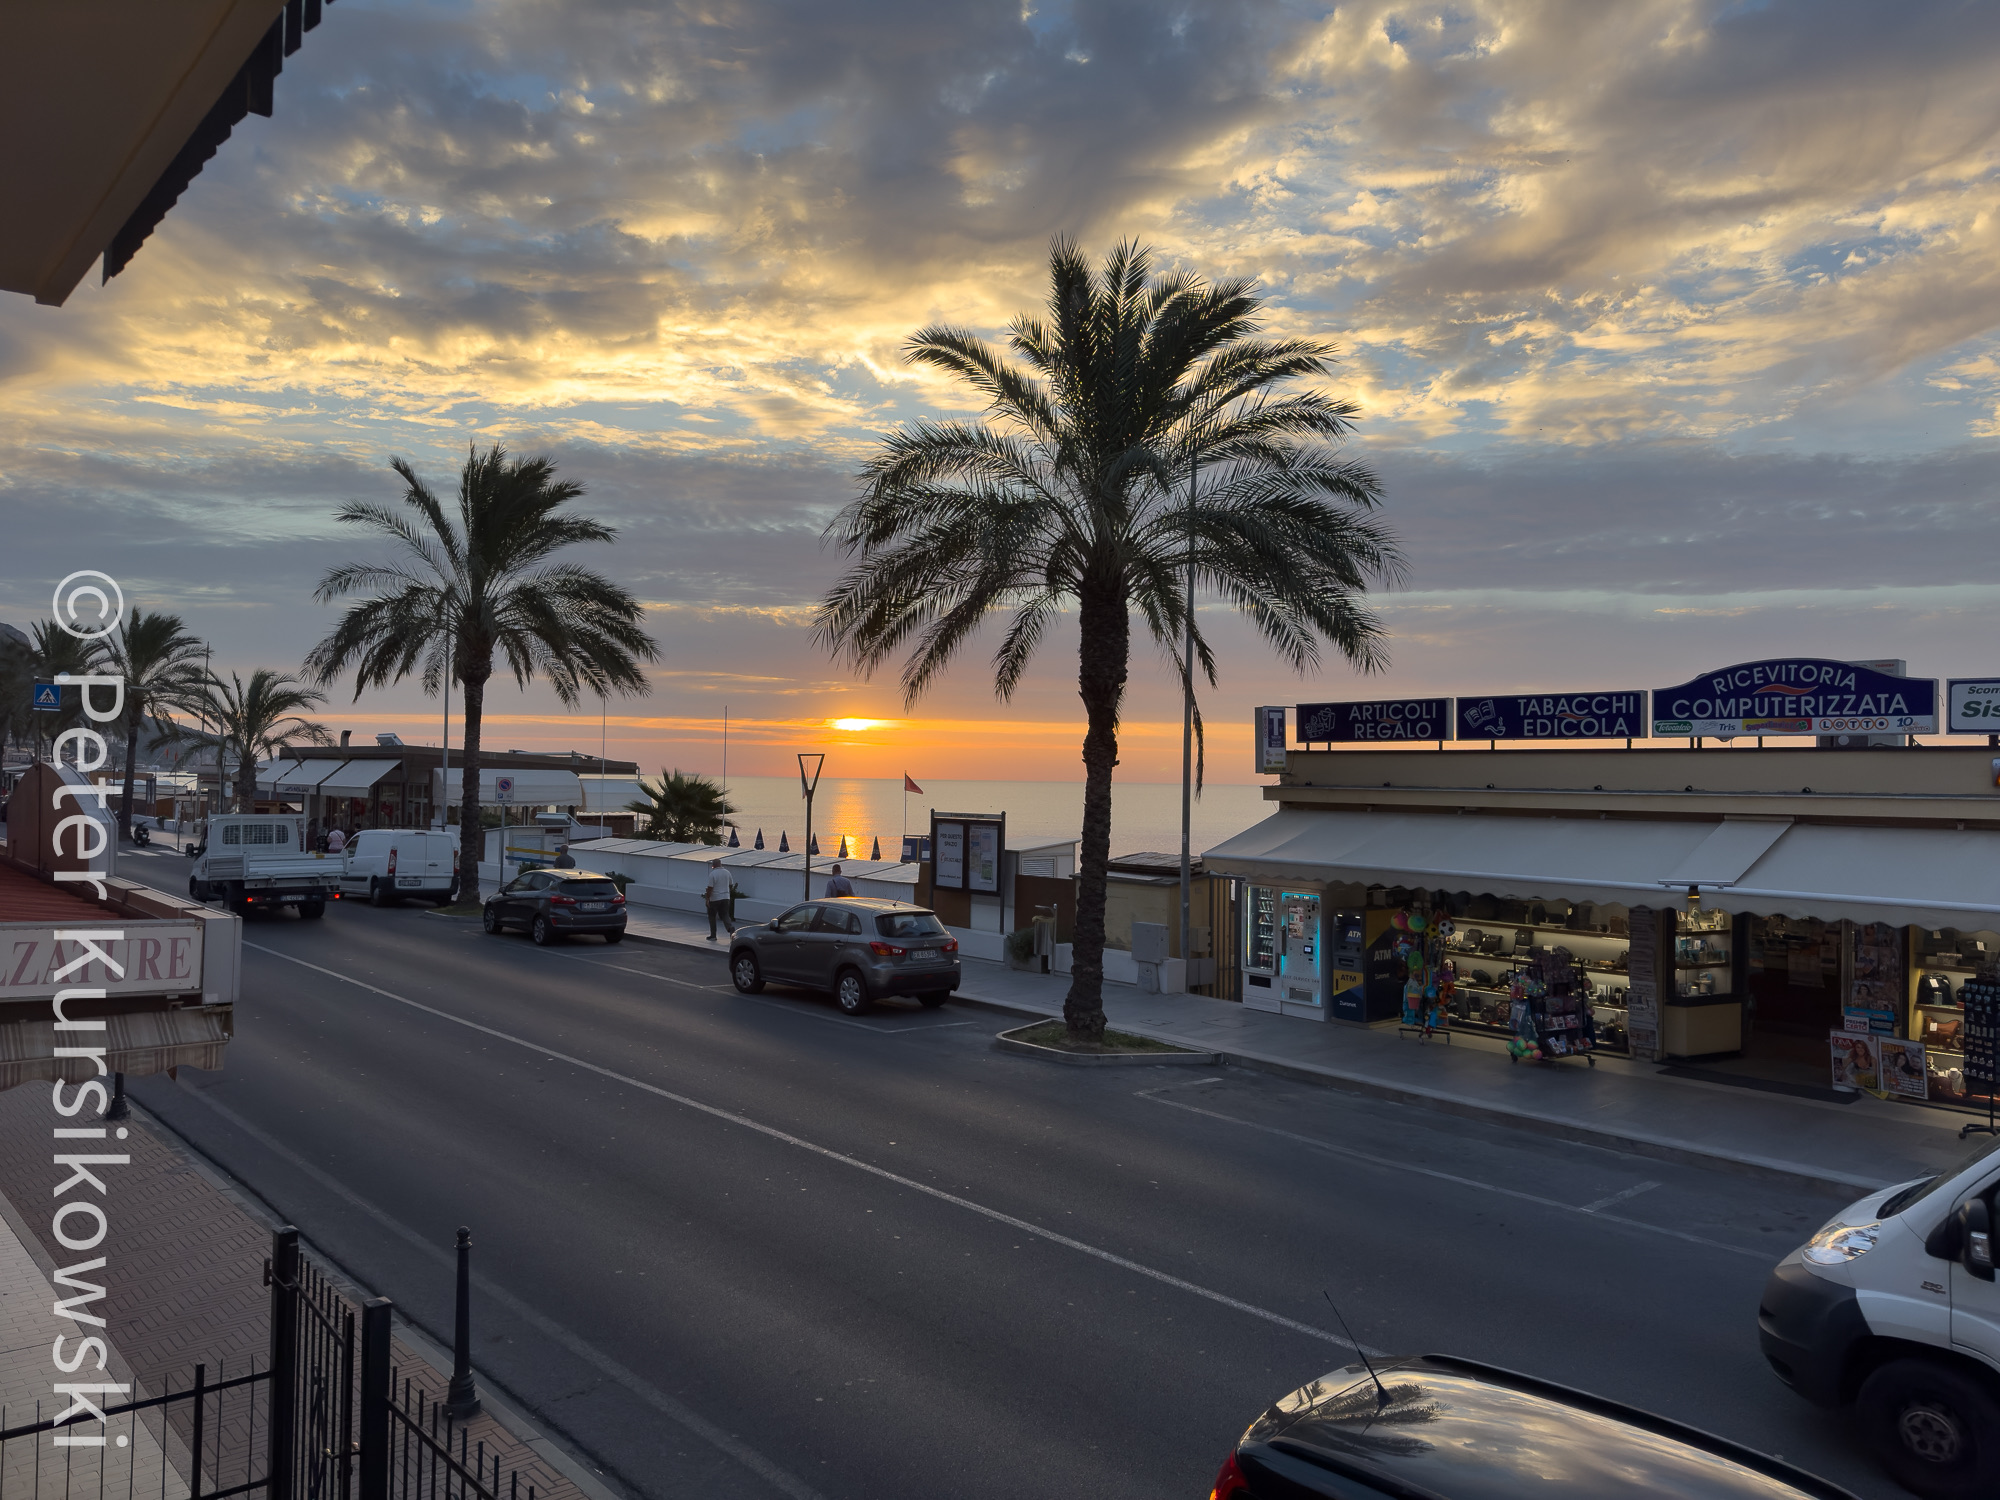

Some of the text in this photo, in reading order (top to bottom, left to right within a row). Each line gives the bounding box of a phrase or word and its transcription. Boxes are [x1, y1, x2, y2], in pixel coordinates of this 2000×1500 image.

[1712, 664, 1856, 695] RICEVITORIA
[1348, 702, 1436, 721] ARTICOLI
[1517, 695, 1634, 716] TABACCHI
[1672, 693, 1909, 718] COMPUTERIZZATA
[1269, 712, 1283, 736] T
[1354, 721, 1432, 739] REGALO
[1524, 717, 1630, 736] EDICOLA
[1656, 722, 1692, 732] Totocalcio
[1719, 723, 1736, 731] Tris
[0, 937, 191, 987] ZATURE
[1374, 949, 1392, 961] ATM
[1340, 974, 1357, 983] ATM
